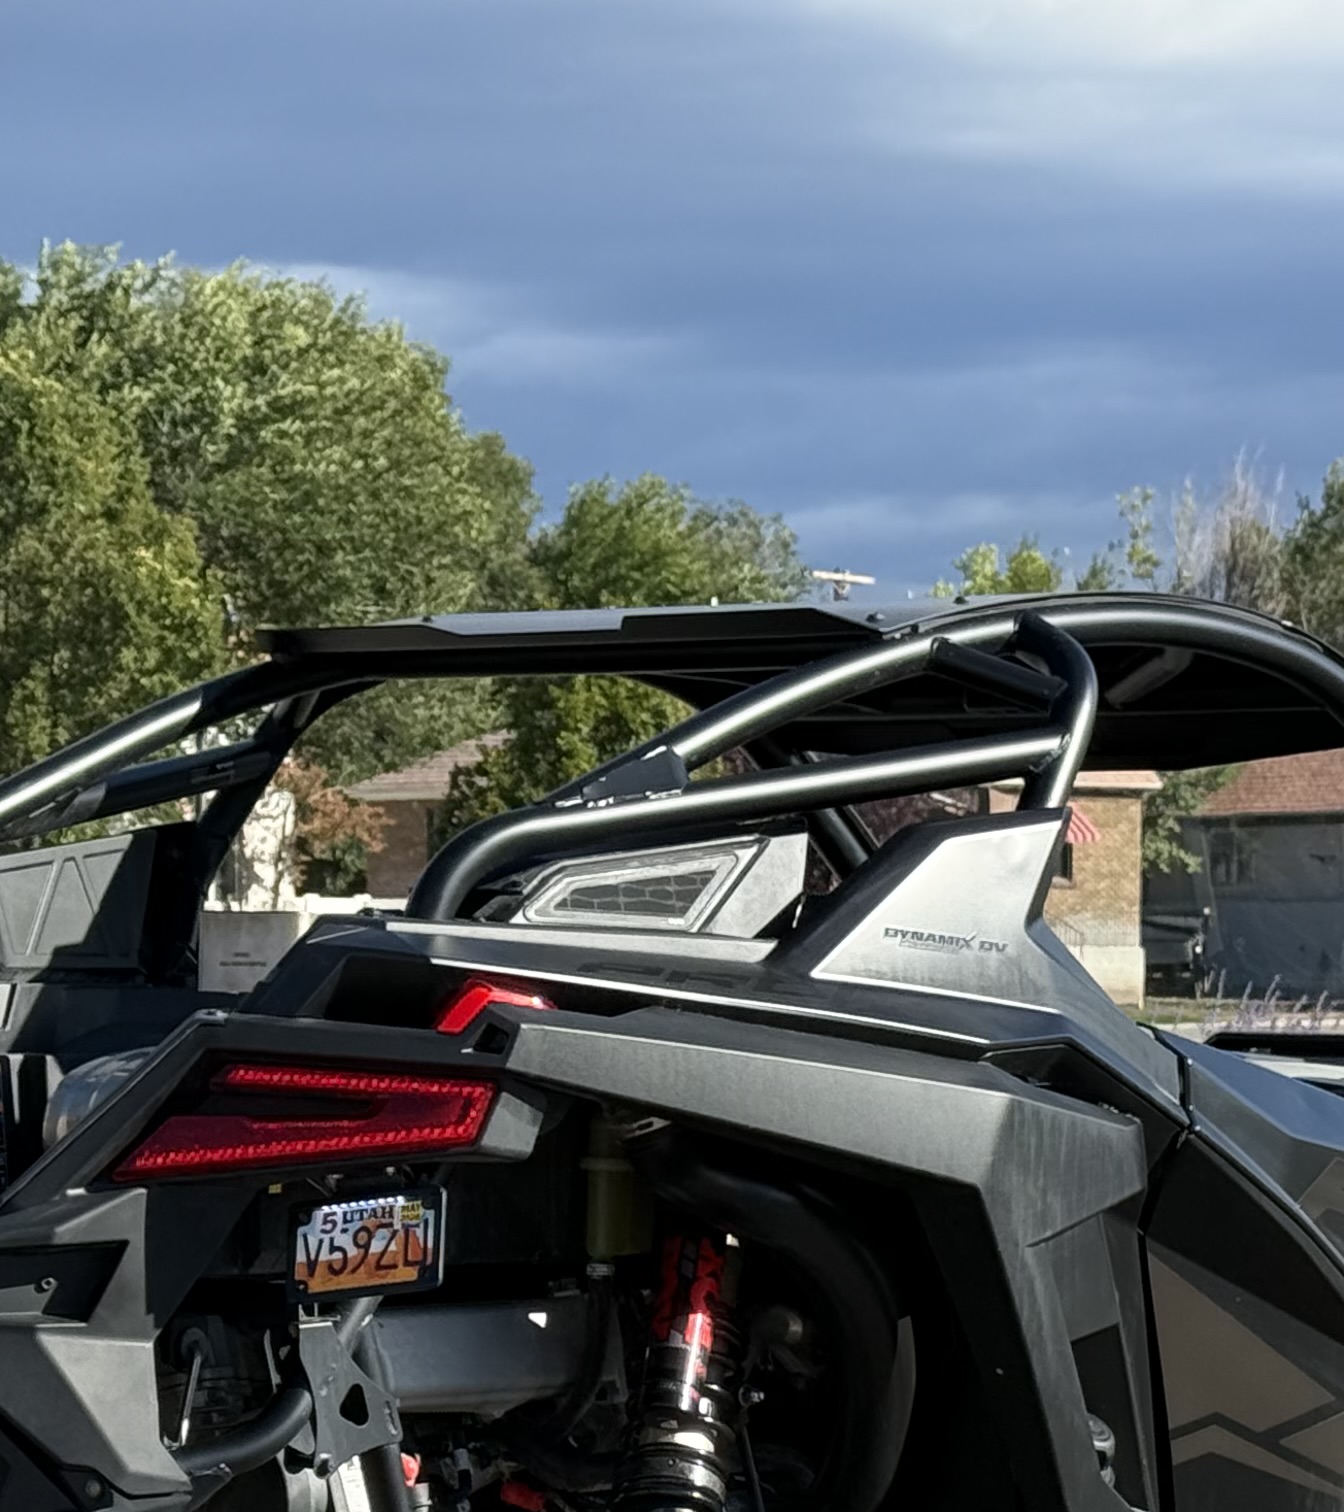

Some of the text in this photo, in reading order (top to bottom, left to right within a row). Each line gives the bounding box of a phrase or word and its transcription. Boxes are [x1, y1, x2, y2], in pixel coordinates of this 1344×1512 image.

[883, 926, 978, 951] DYNAMIX
[978, 940, 1009, 953] DV
[319, 1210, 339, 1235] 5
[342, 1204, 395, 1224] UTAH
